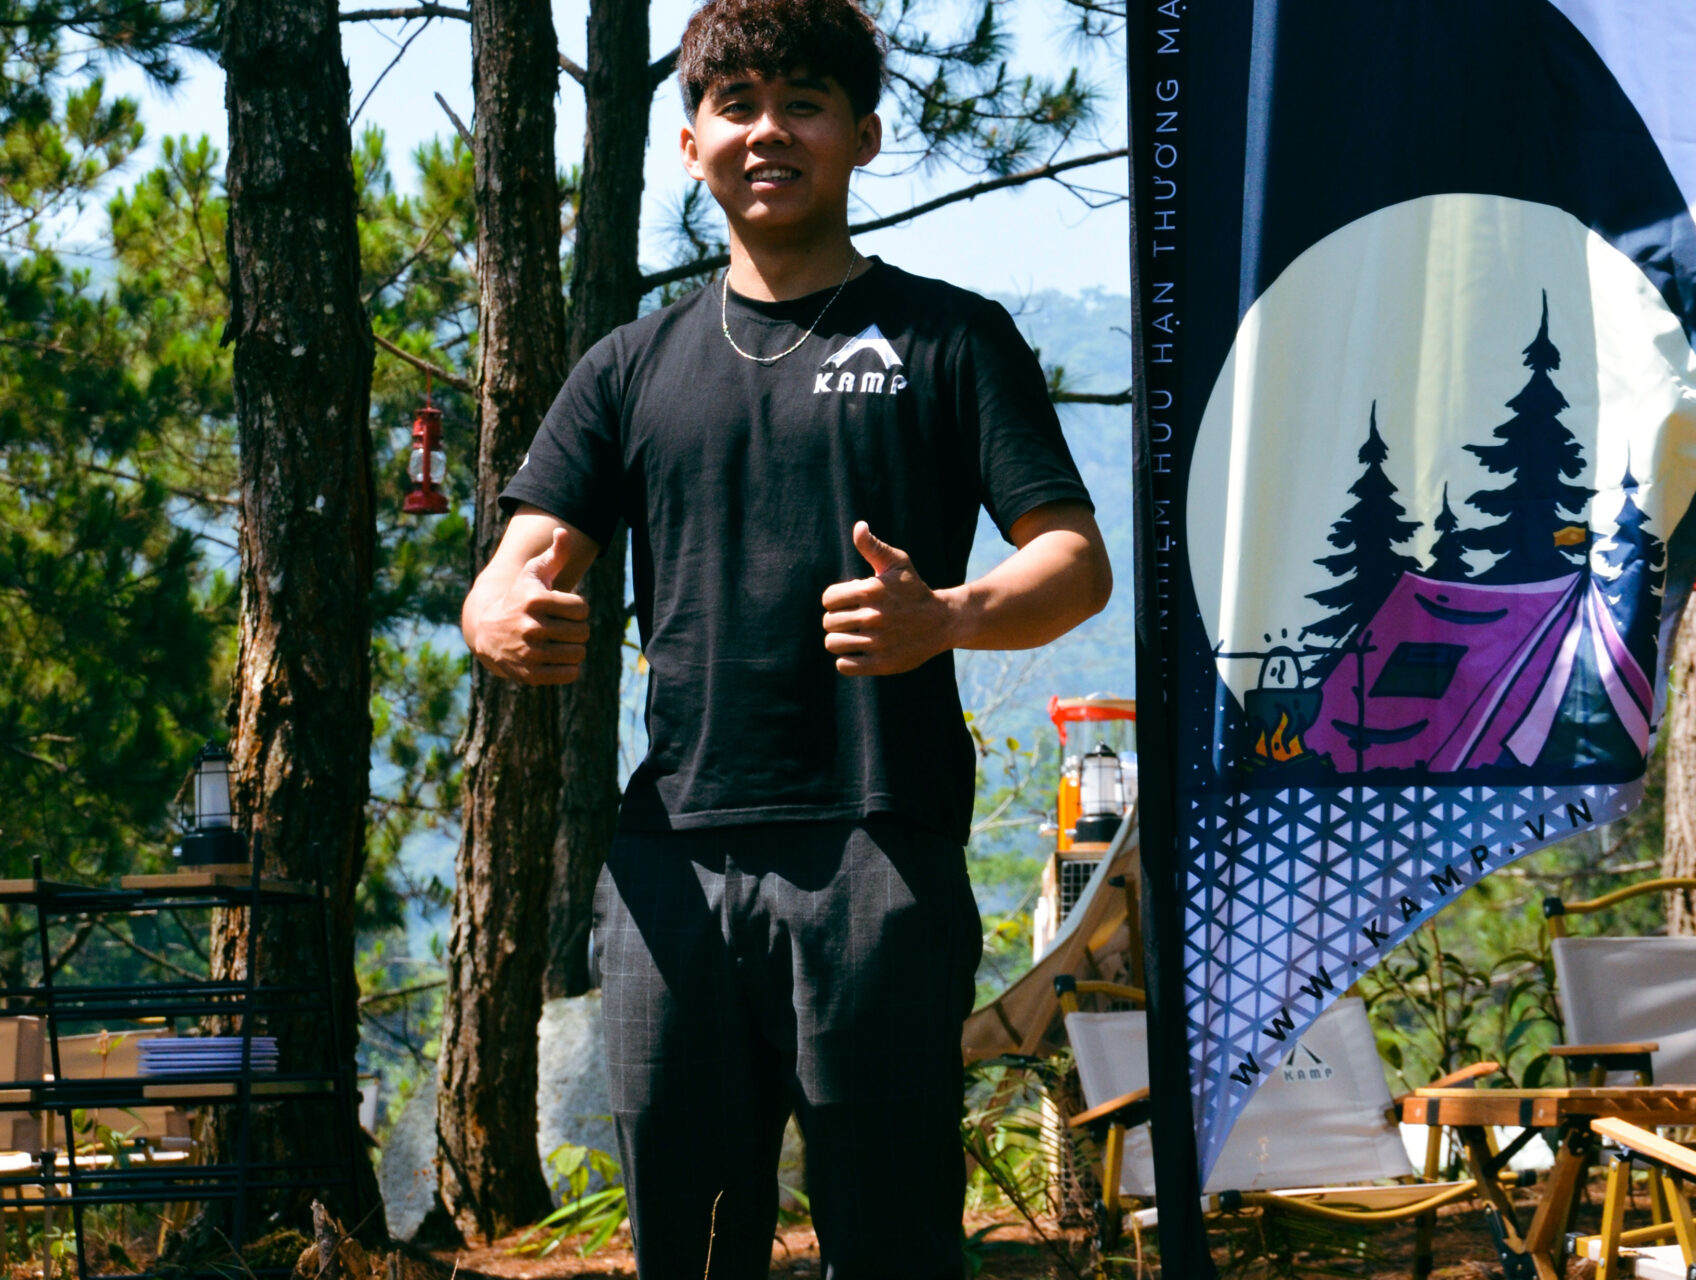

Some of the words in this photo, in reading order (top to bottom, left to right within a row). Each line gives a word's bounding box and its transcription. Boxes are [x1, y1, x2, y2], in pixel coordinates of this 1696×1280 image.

[1151, 79, 1180, 257] THƯƠNG
[1153, 282, 1181, 364] HẠN
[813, 372, 908, 395] KAMP
[1283, 1067, 1333, 1081] KAMP
